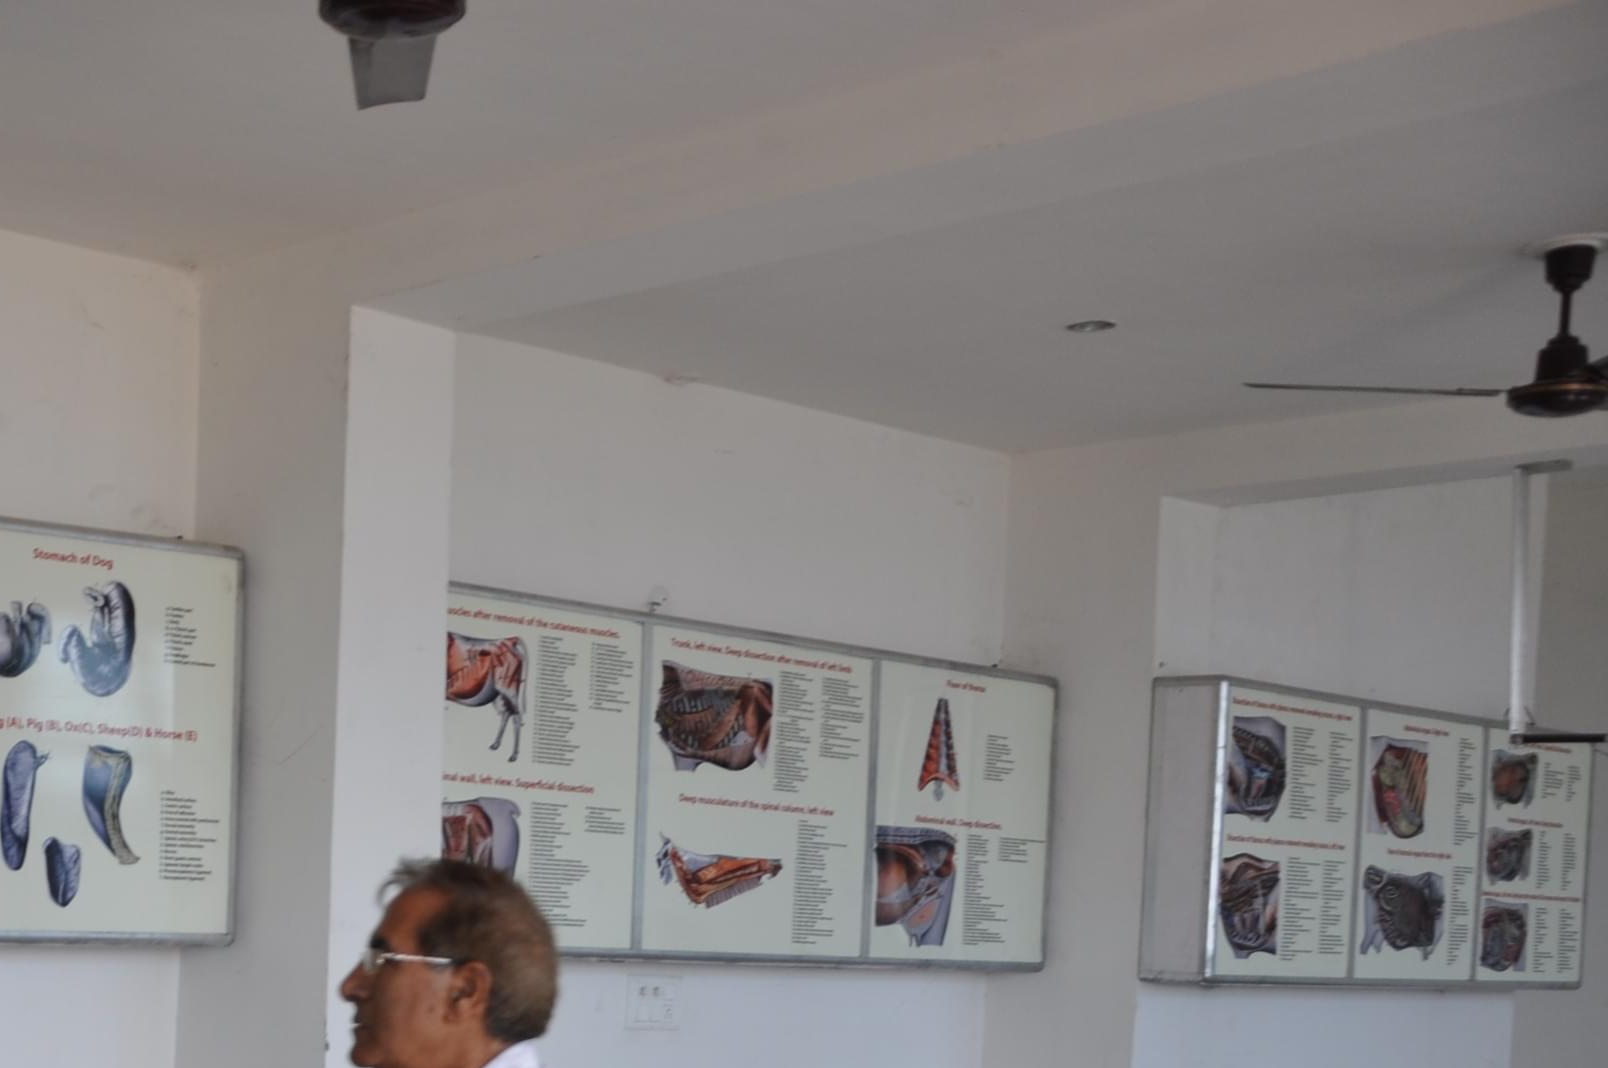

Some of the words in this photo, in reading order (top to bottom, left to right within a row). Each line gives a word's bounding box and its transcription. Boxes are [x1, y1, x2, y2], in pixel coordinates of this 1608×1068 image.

[33, 547, 78, 565] Stomach
[80, 553, 90, 566] of
[92, 555, 114, 571] Dog
[26, 718, 43, 733] Pig
[154, 727, 183, 740] Horse
